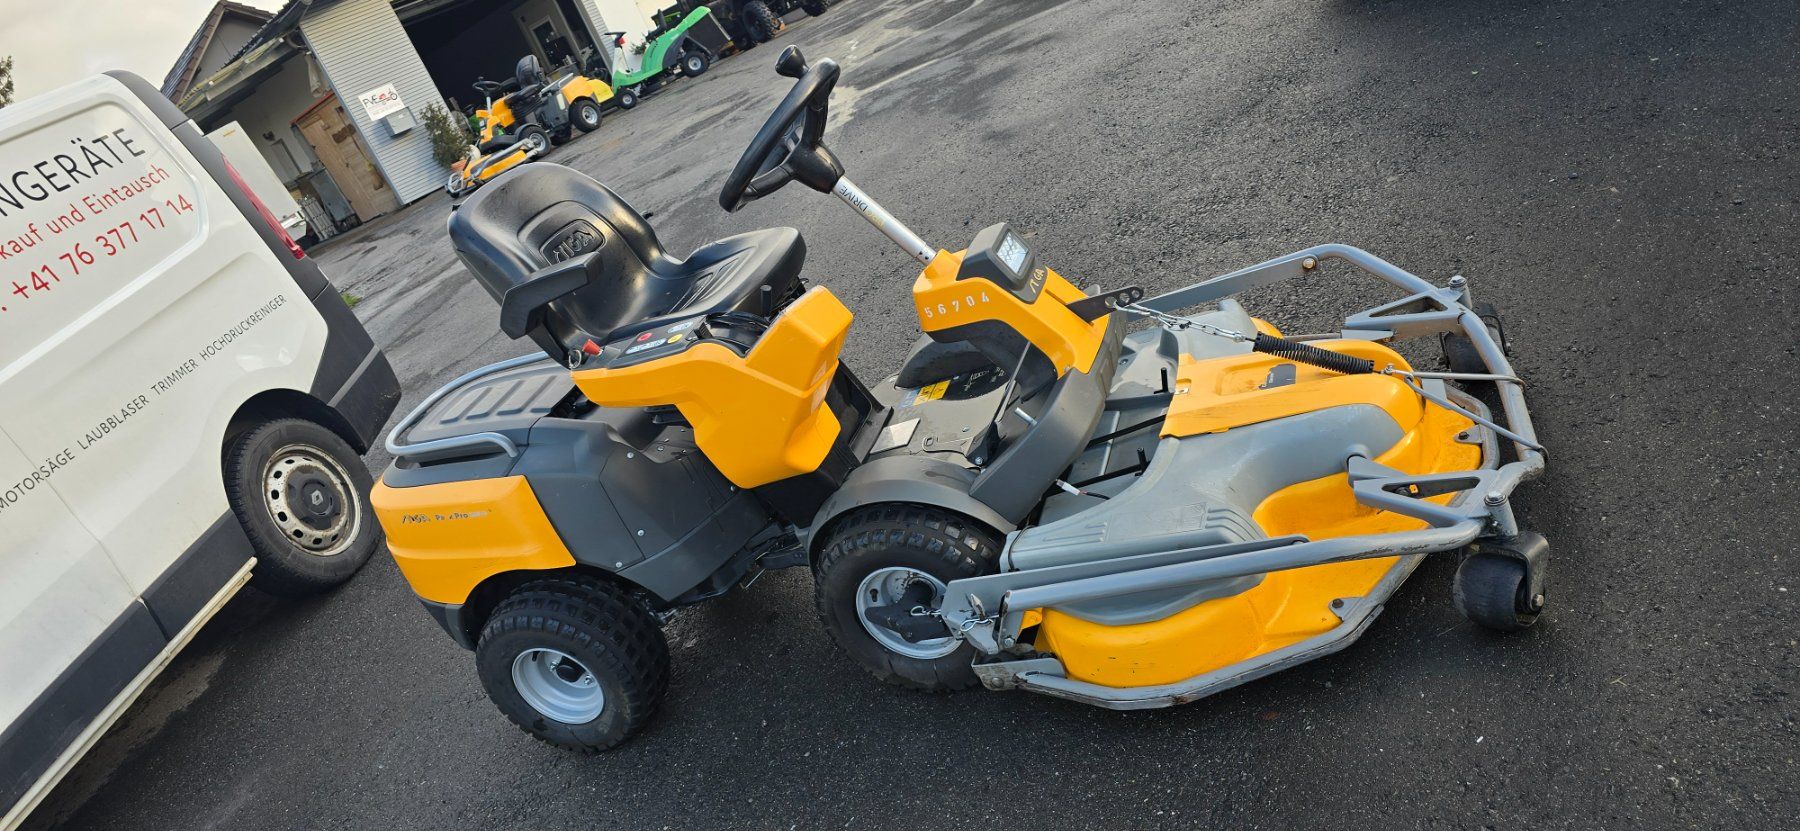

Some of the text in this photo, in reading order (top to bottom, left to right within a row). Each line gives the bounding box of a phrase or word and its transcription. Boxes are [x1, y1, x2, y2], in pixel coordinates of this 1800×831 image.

[0, 164, 170, 260] kauf und Eintausch
[12, 194, 194, 299] +41 76 377 17 14
[840, 185, 868, 212] DRIVE
[77, 394, 149, 450] LAUBBLASER
[151, 358, 199, 396] TRIMMER
[199, 294, 287, 361] HOCHDRUCKREINIGER
